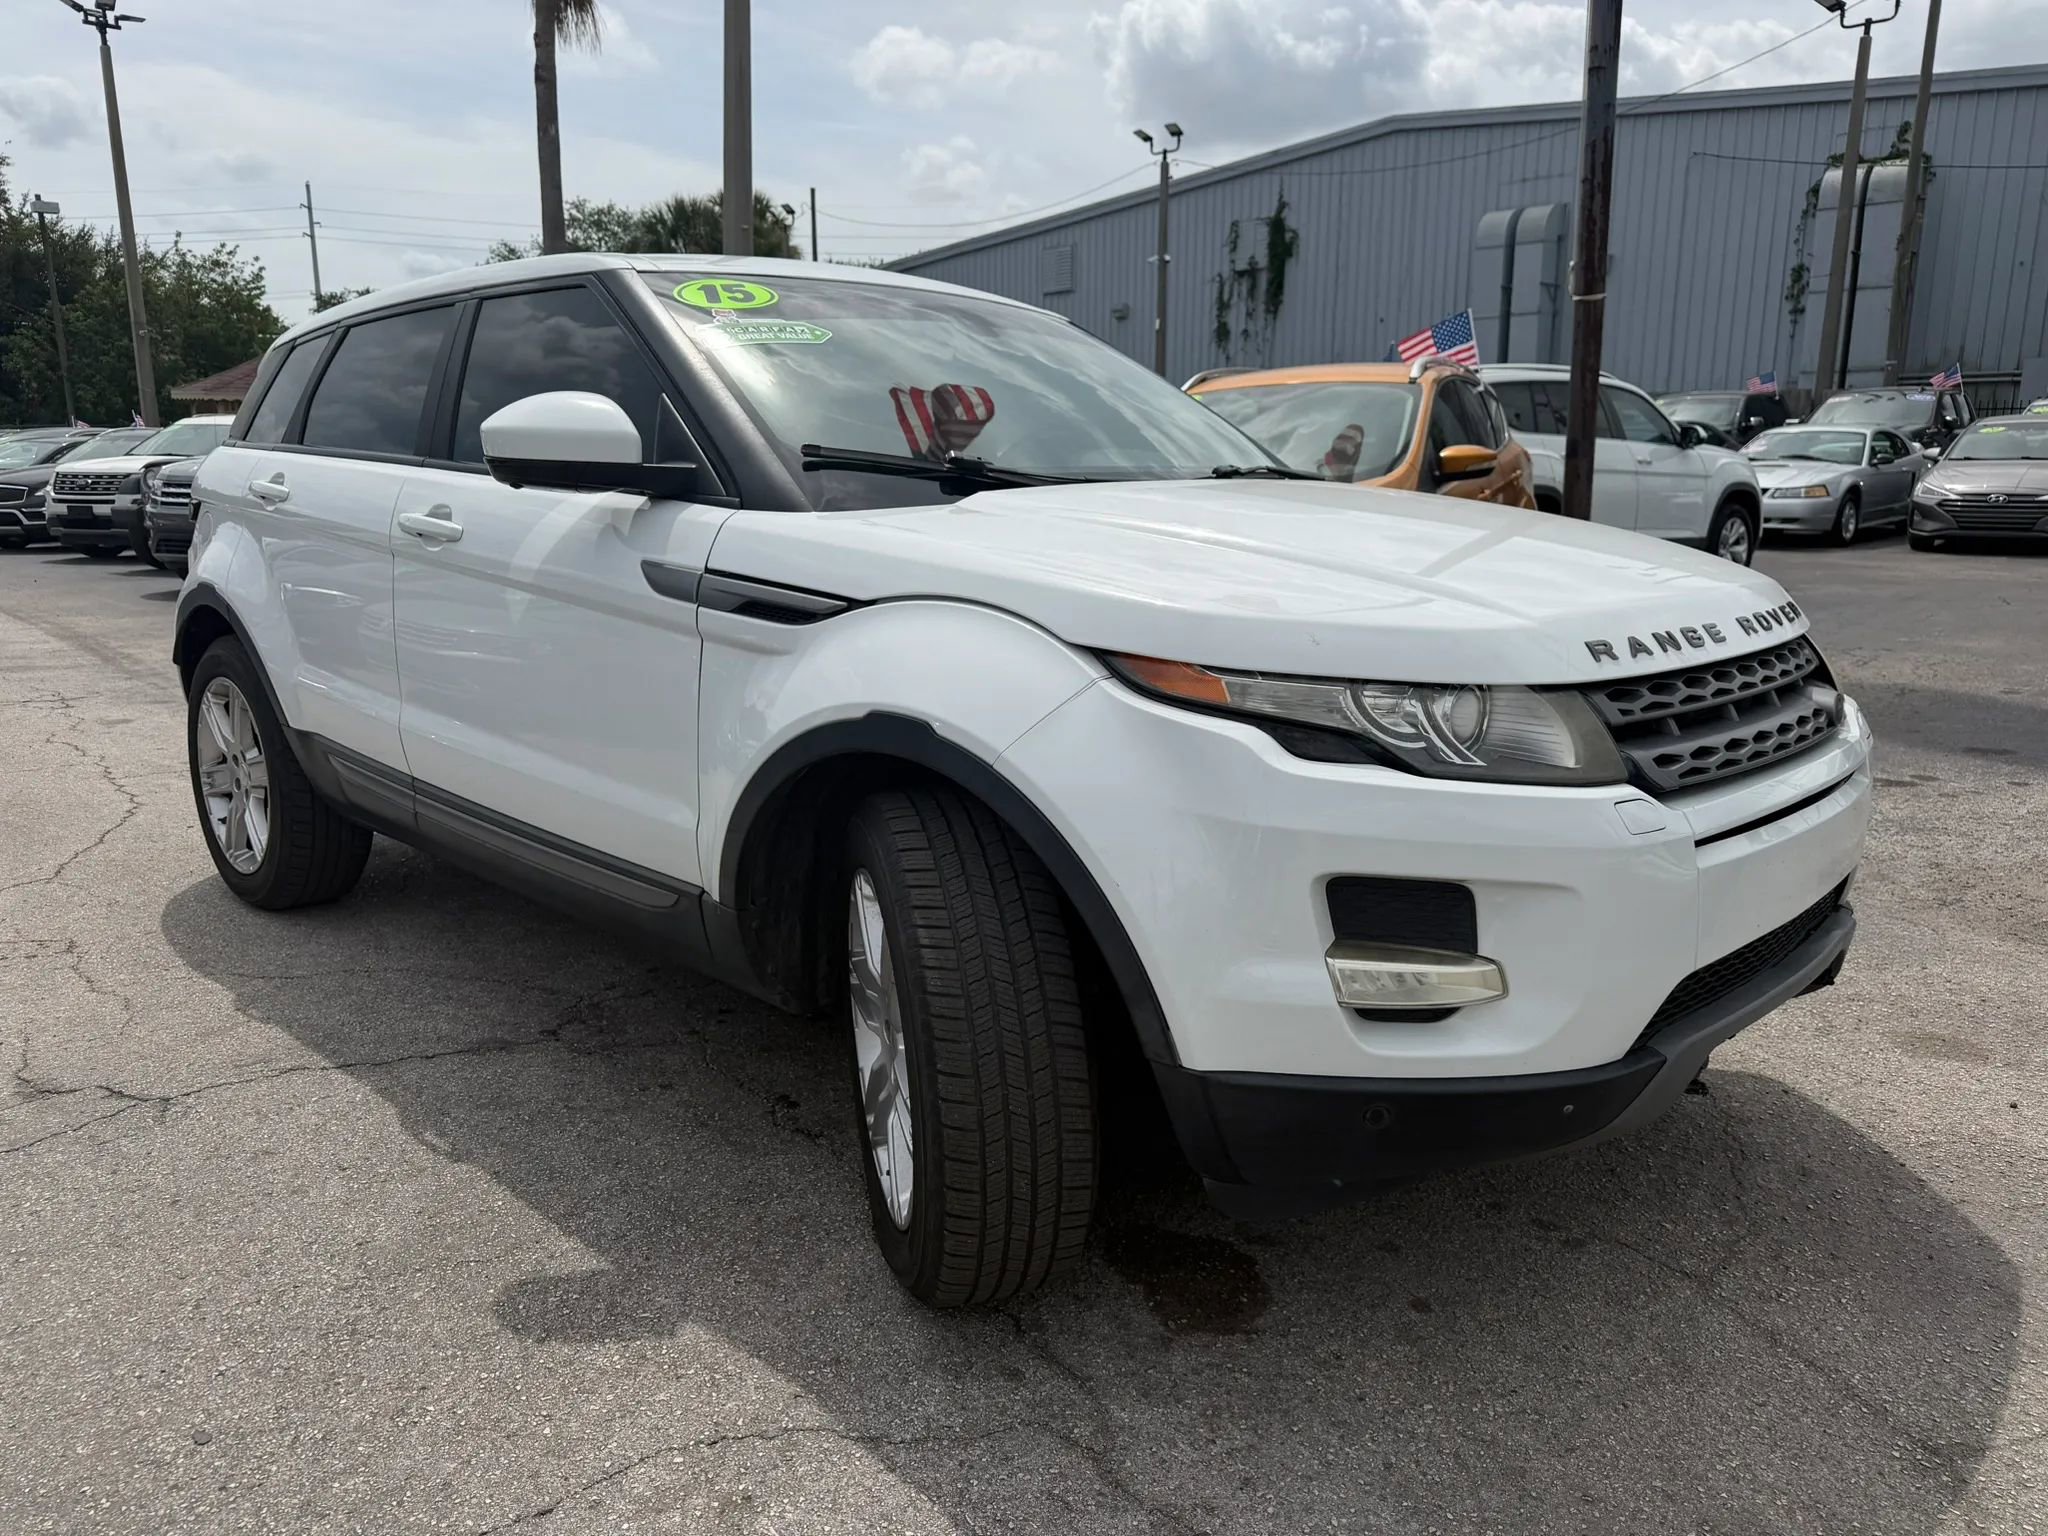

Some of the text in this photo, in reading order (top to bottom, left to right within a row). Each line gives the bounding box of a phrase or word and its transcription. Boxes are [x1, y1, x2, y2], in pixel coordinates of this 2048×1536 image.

[697, 284, 756, 304] 15
[1584, 600, 1802, 663] RANGE ROVER
